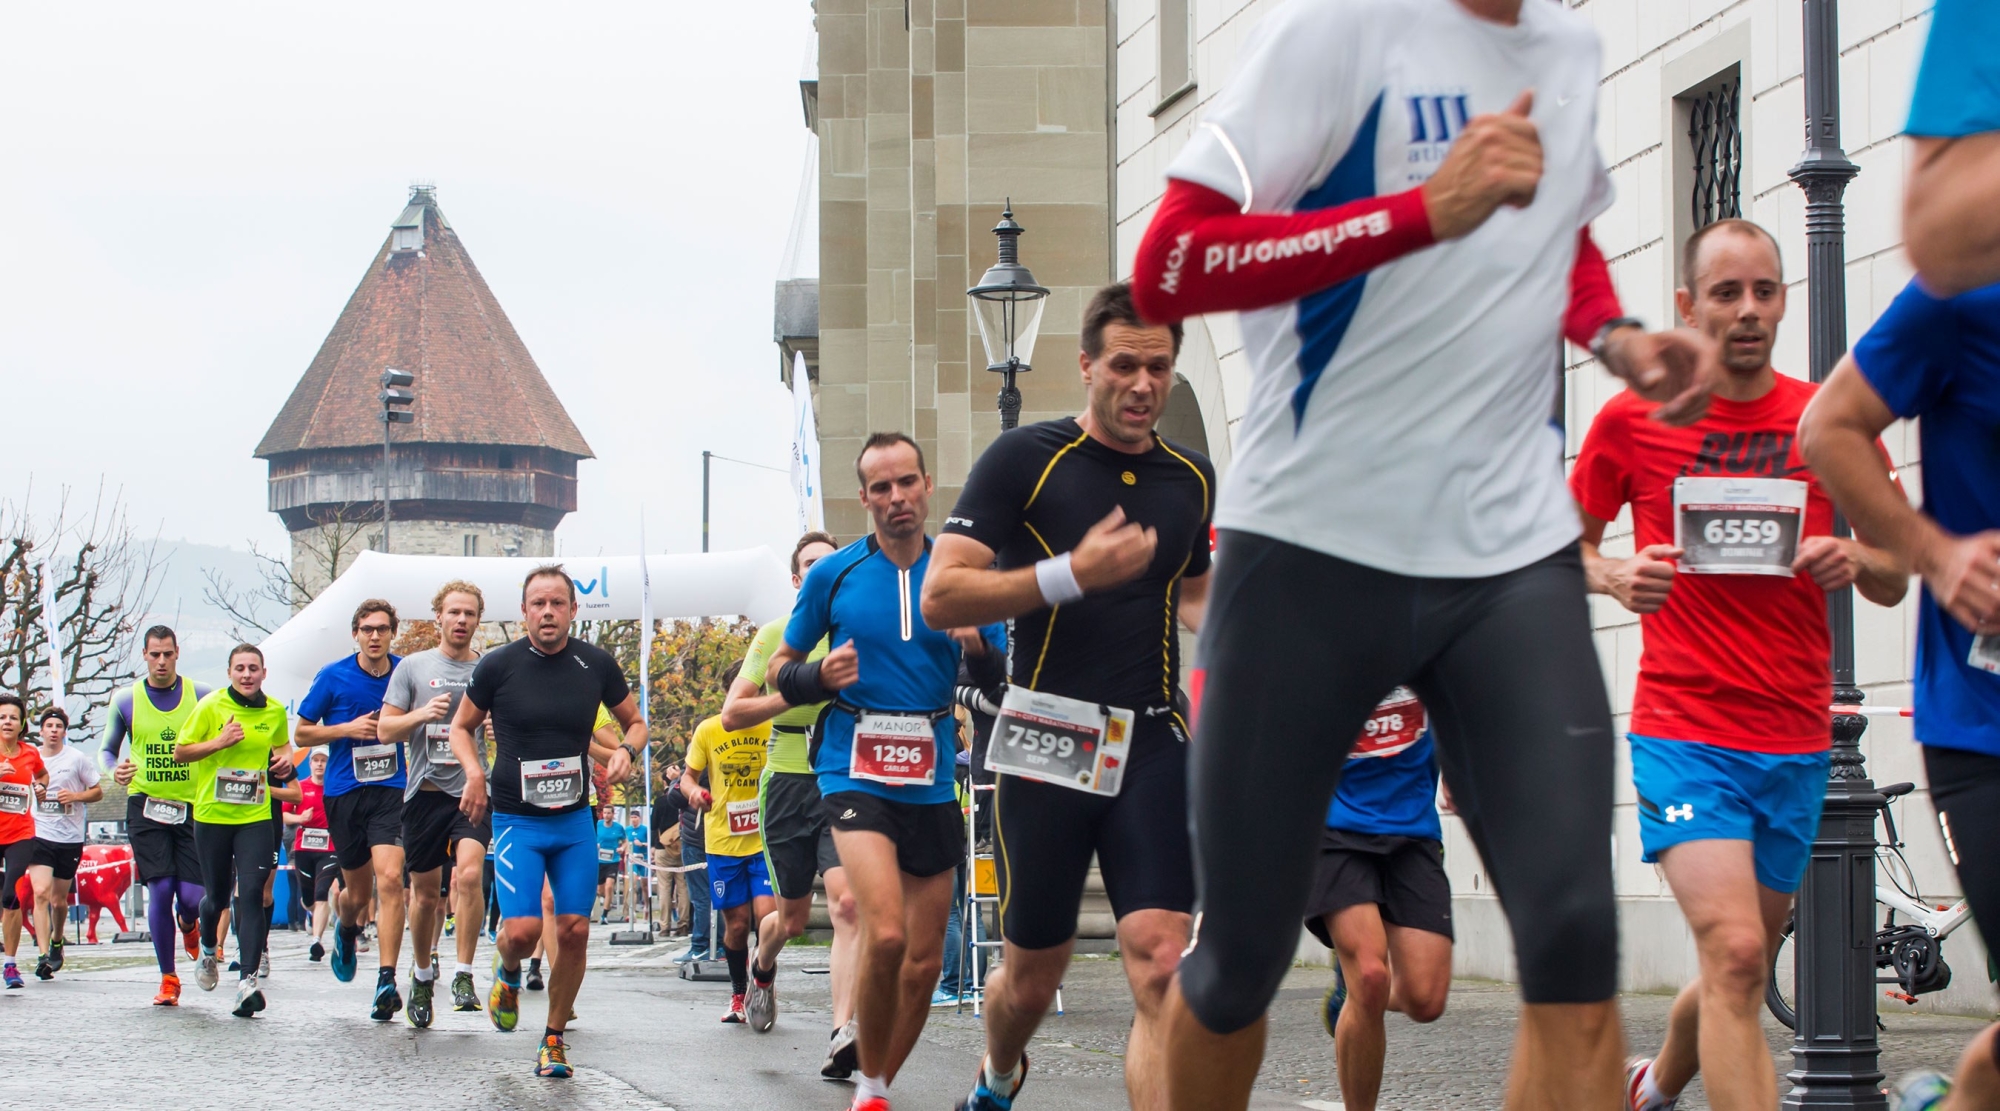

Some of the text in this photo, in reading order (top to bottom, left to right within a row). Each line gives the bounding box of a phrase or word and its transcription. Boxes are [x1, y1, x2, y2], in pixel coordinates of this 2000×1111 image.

[1204, 209, 1393, 274] Barloworld
[1693, 432, 1794, 475] RUN
[1704, 519, 1781, 545] 6559
[872, 721, 922, 733] MANOR
[1022, 714, 1037, 722] CITY
[1038, 716, 1076, 730] MARATHON
[1364, 714, 1405, 737] 978
[146, 743, 175, 755] HELE
[713, 742, 730, 755] THE
[731, 736, 759, 747] BLACK
[1007, 725, 1075, 758] 7599
[873, 744, 922, 764] 1296
[1026, 754, 1049, 765] SEPP
[364, 758, 391, 771] 2947
[883, 764, 910, 773] CARLOS
[146, 770, 190, 782] ULTRAS!
[724, 779, 733, 787] EL
[225, 783, 252, 793] 6449
[536, 778, 572, 793] 6597
[153, 804, 178, 816] 4688
[734, 813, 759, 828] 178
